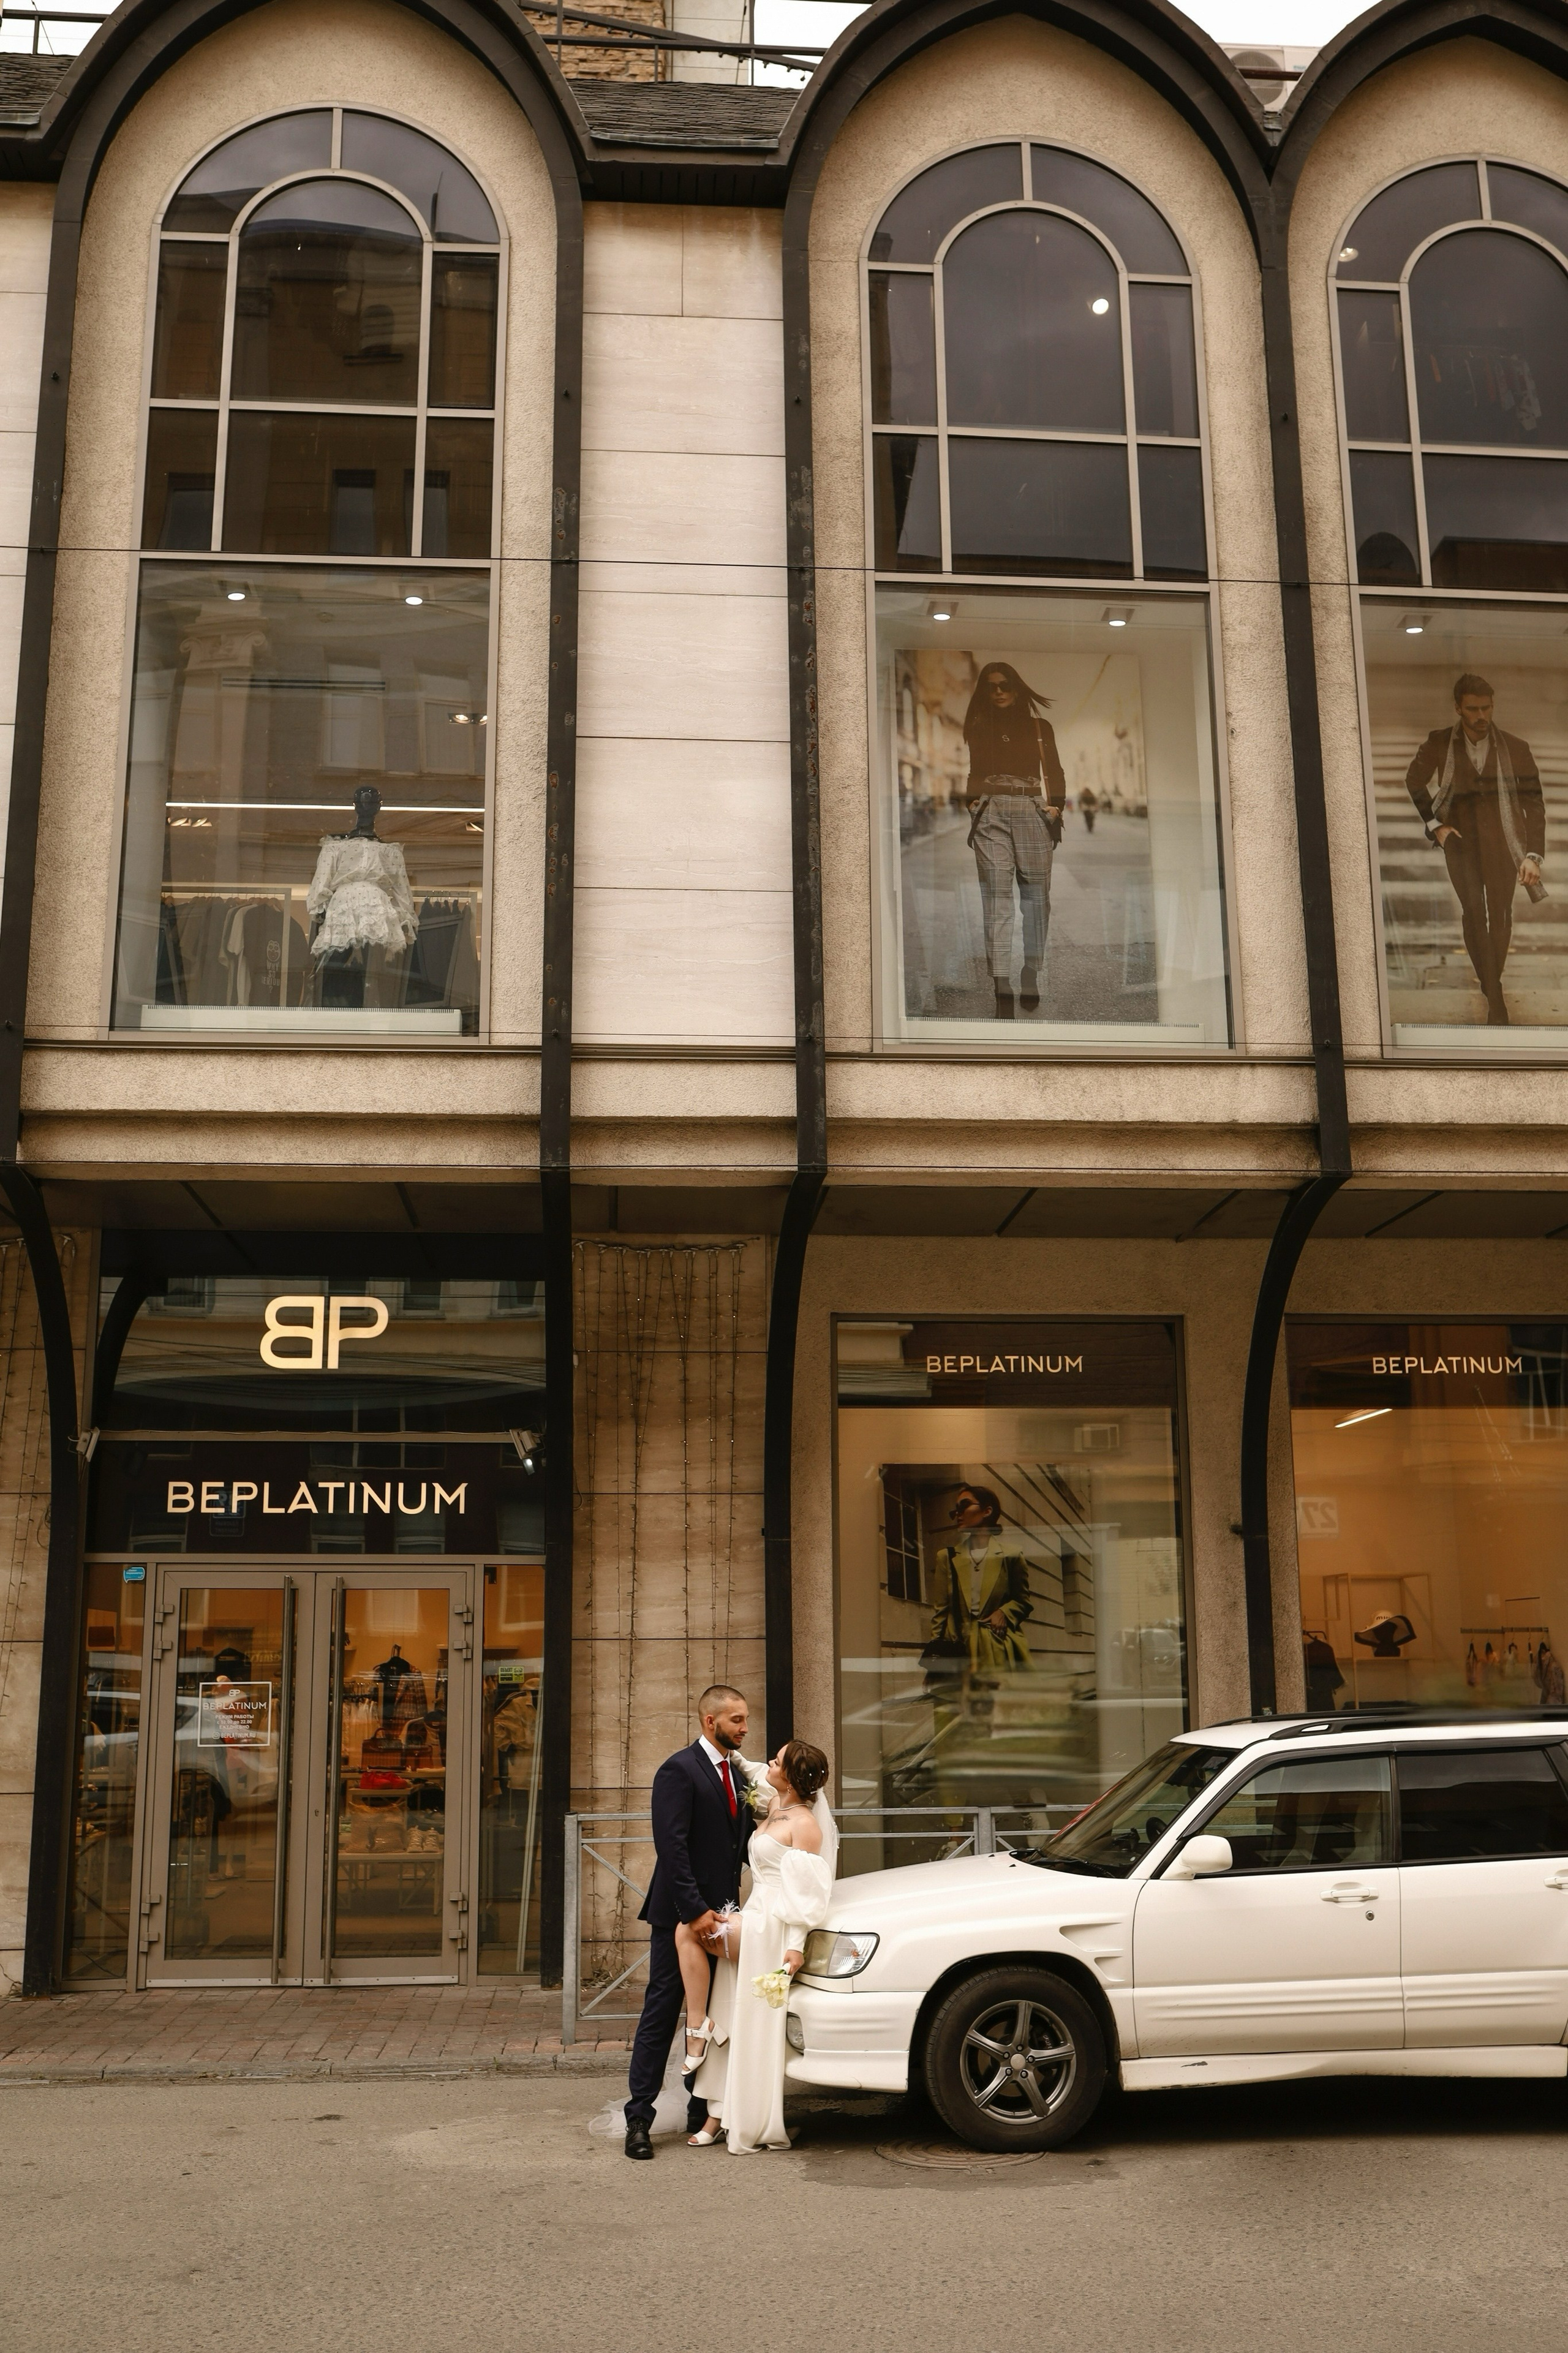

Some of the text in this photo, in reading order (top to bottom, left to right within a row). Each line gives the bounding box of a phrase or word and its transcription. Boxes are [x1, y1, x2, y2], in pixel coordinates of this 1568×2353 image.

[260, 1296, 388, 1369] BP
[927, 1355, 1083, 1373] BEPLATINUM
[1373, 1356, 1523, 1373] BEPLATINUM
[167, 1481, 468, 1514] BEPLATINUM
